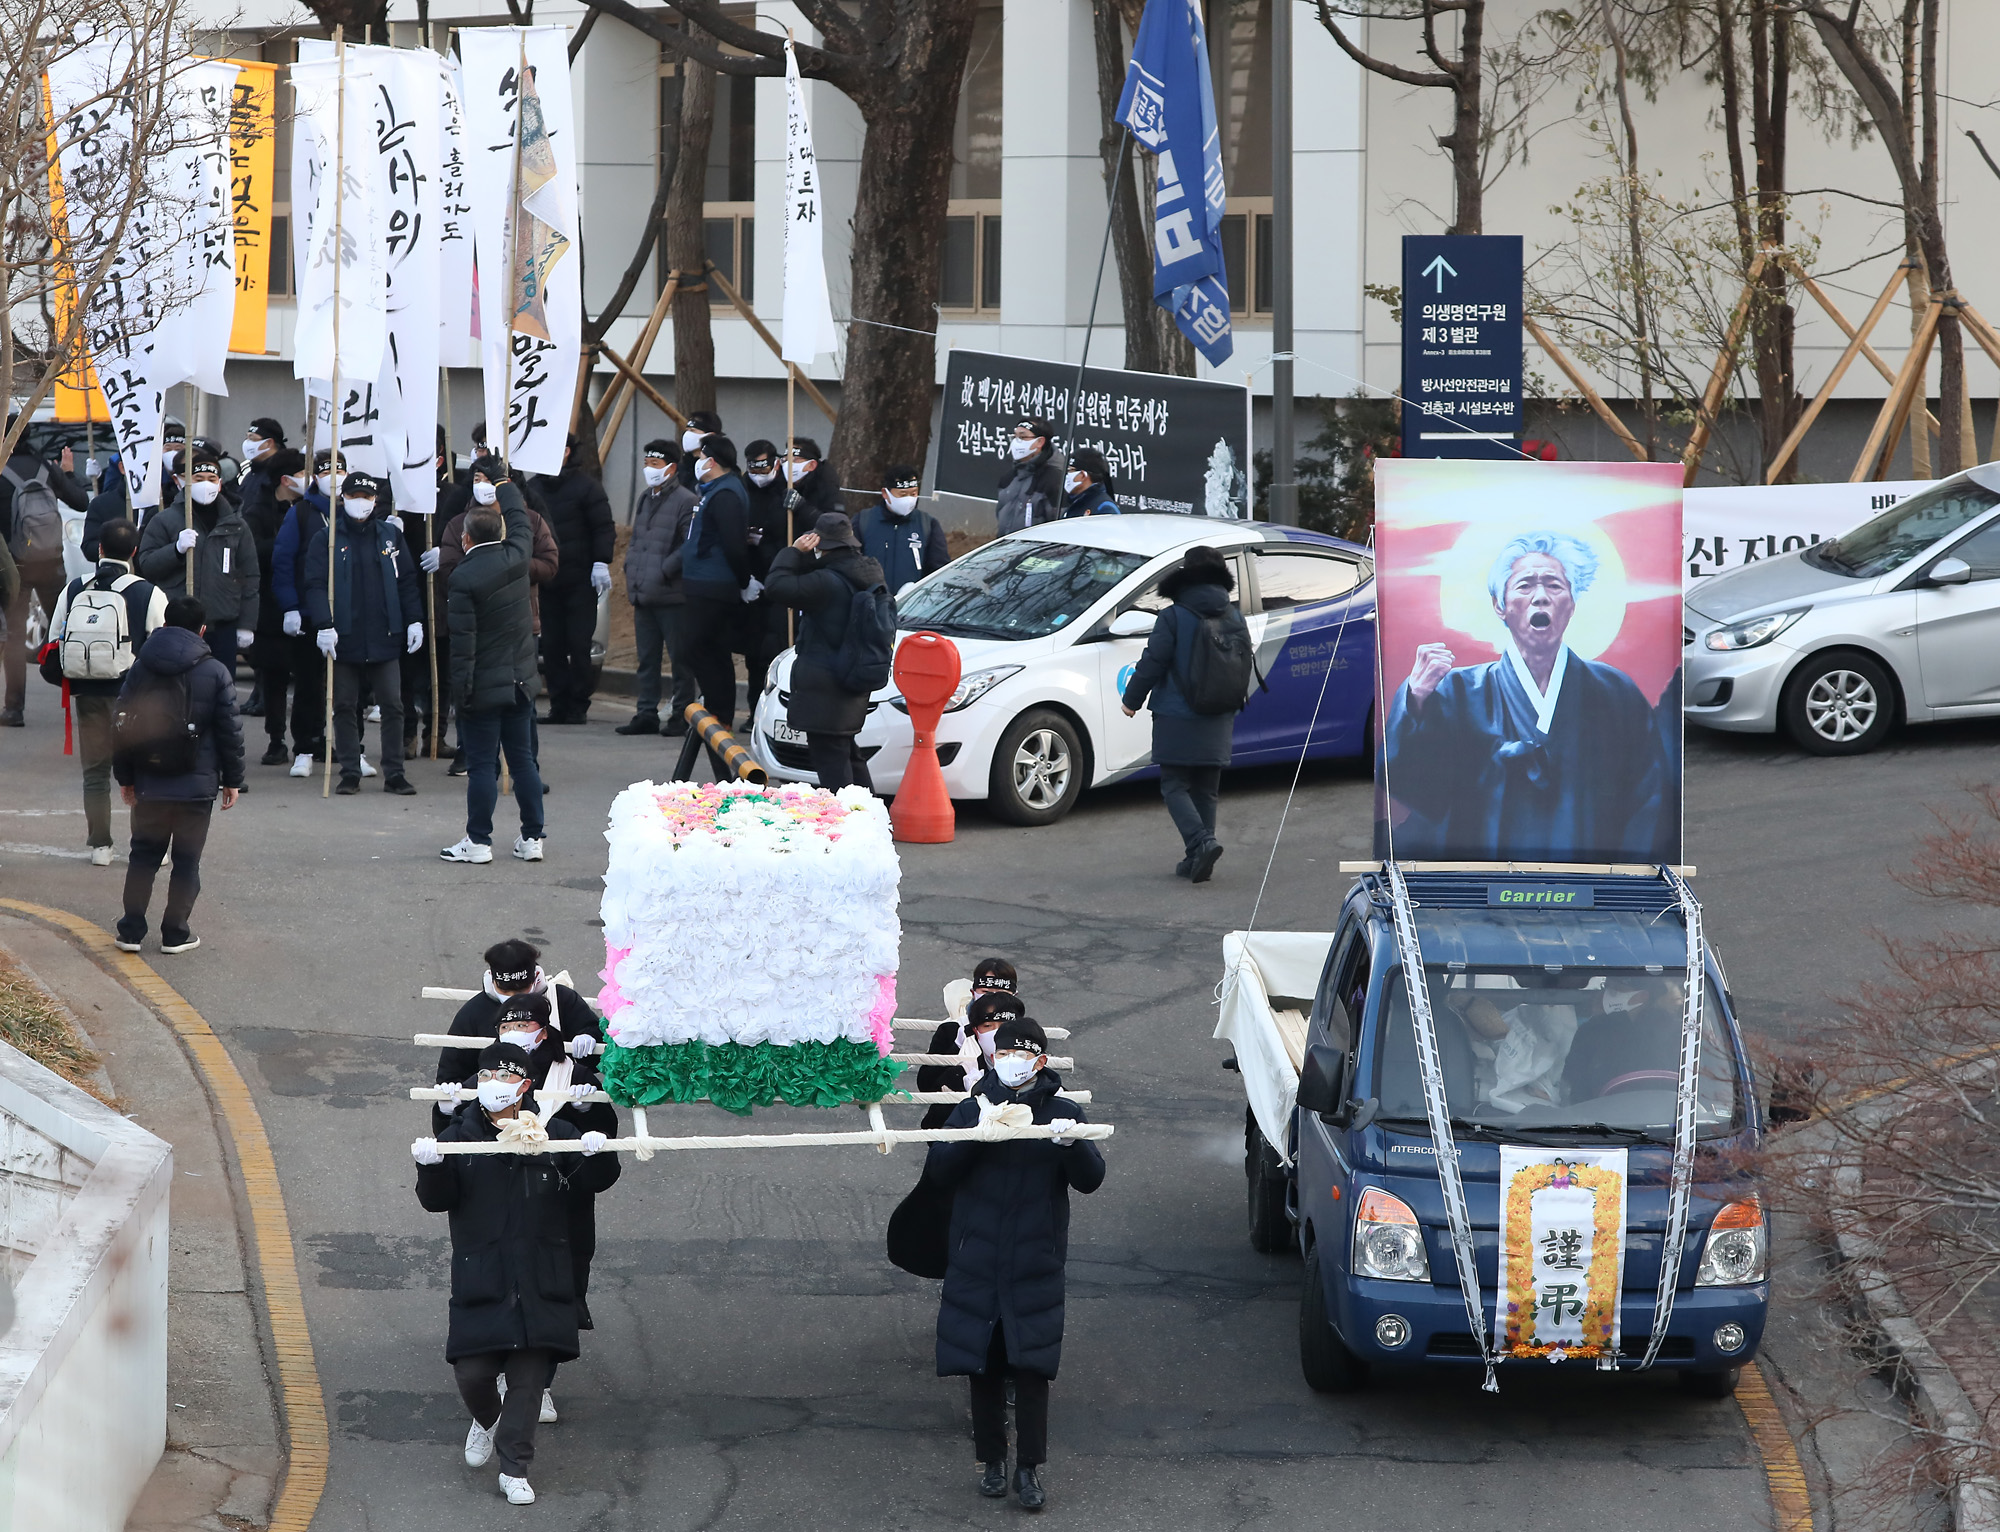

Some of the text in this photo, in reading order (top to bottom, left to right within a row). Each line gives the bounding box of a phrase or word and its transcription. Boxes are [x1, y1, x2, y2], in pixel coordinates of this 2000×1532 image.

[1422, 304, 1507, 322] 의생명연구원
[1421, 378, 1511, 393] 방사선안전관리실
[961, 375, 975, 408] 故
[977, 376, 1016, 415] 백기완
[1017, 382, 1070, 425] 선생님이
[1115, 394, 1169, 436] 민중세상
[1421, 401, 1515, 416] 건축과 시설보수반
[1499, 889, 1576, 903] Carrier
[495, 970, 528, 982] 노동해방
[978, 977, 1012, 989] 노동해방
[1391, 1145, 1462, 1157] INTERCOR
[1540, 1228, 1585, 1327] 謹弔
